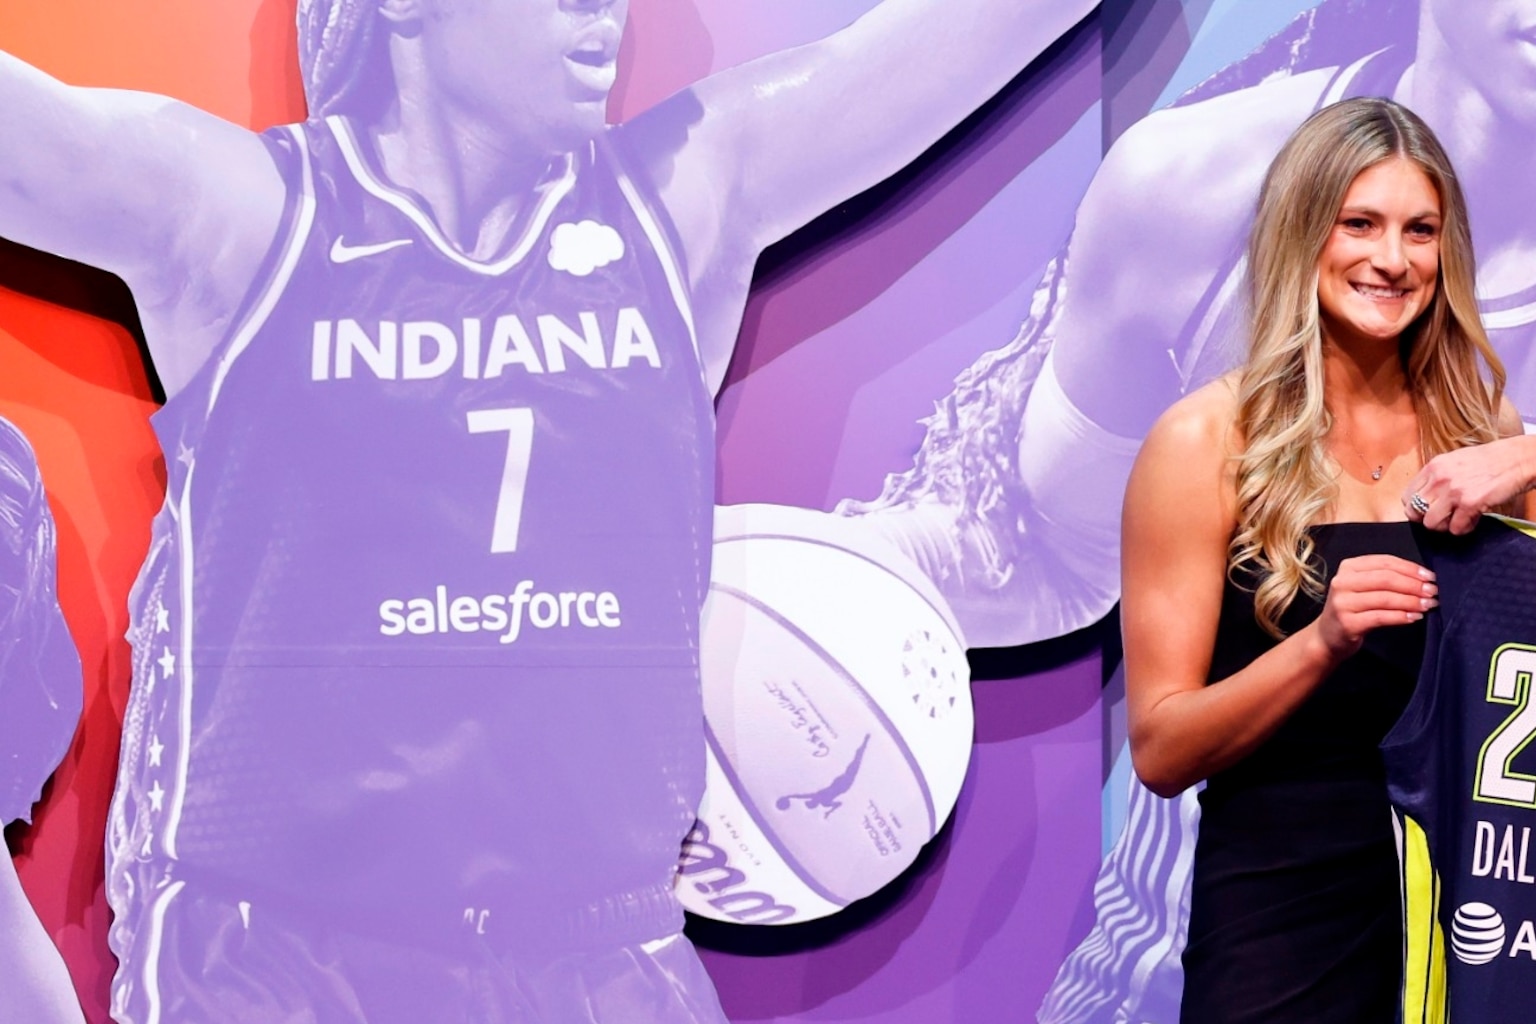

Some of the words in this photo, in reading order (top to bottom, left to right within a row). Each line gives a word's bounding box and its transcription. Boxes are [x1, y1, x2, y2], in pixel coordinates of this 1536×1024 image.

[311, 307, 661, 381] INDIANA
[467, 407, 534, 554] 7
[379, 580, 621, 643] salesforce
